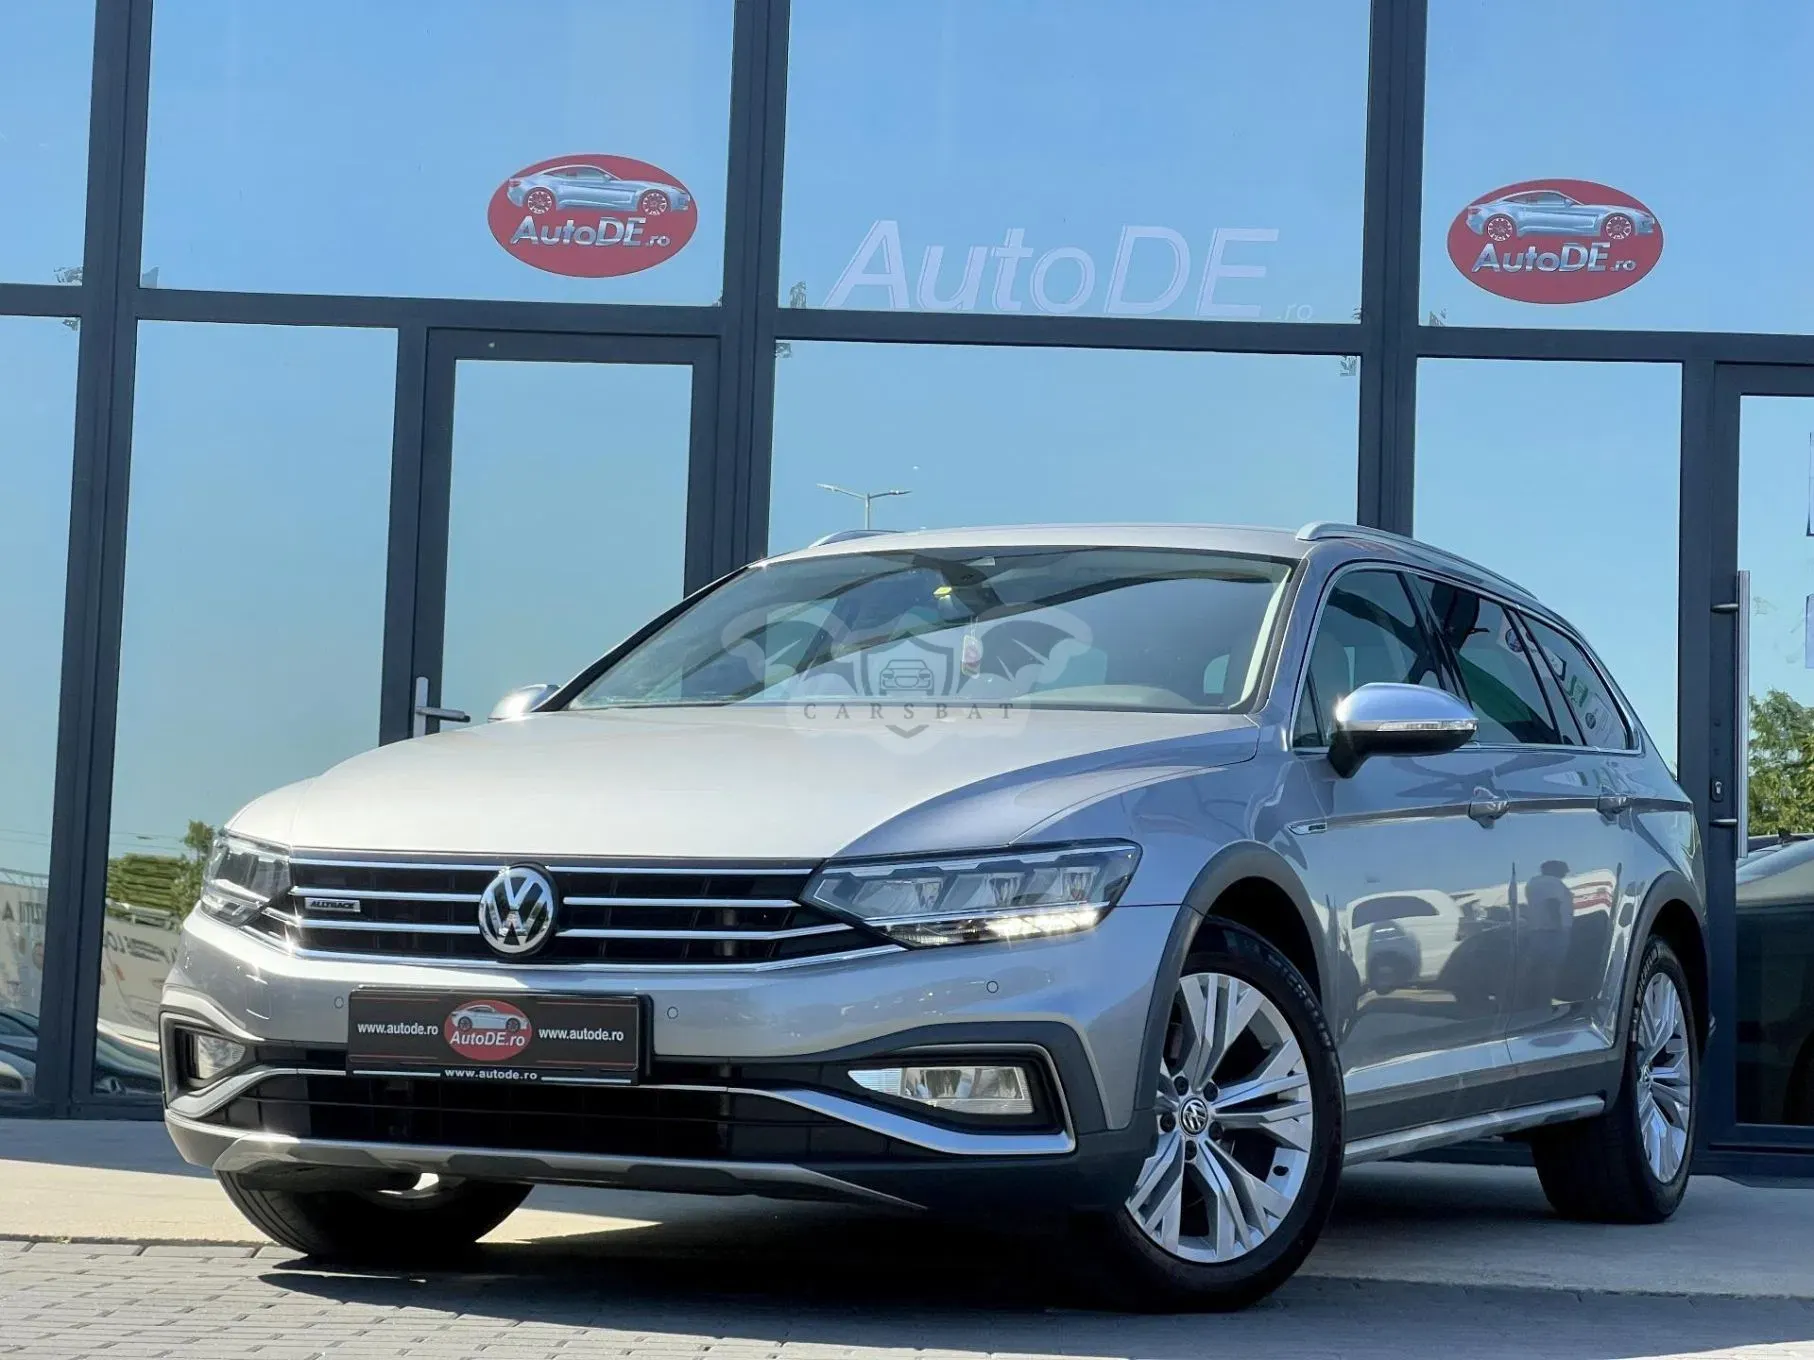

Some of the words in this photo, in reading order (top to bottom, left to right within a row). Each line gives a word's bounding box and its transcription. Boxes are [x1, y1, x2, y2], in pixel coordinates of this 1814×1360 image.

[357, 1021, 439, 1036] www.autode.ro
[538, 1027, 624, 1042] www.autode.ro
[449, 1031, 525, 1047] AutoDE.ro
[444, 1068, 538, 1080] www.autode.ro
